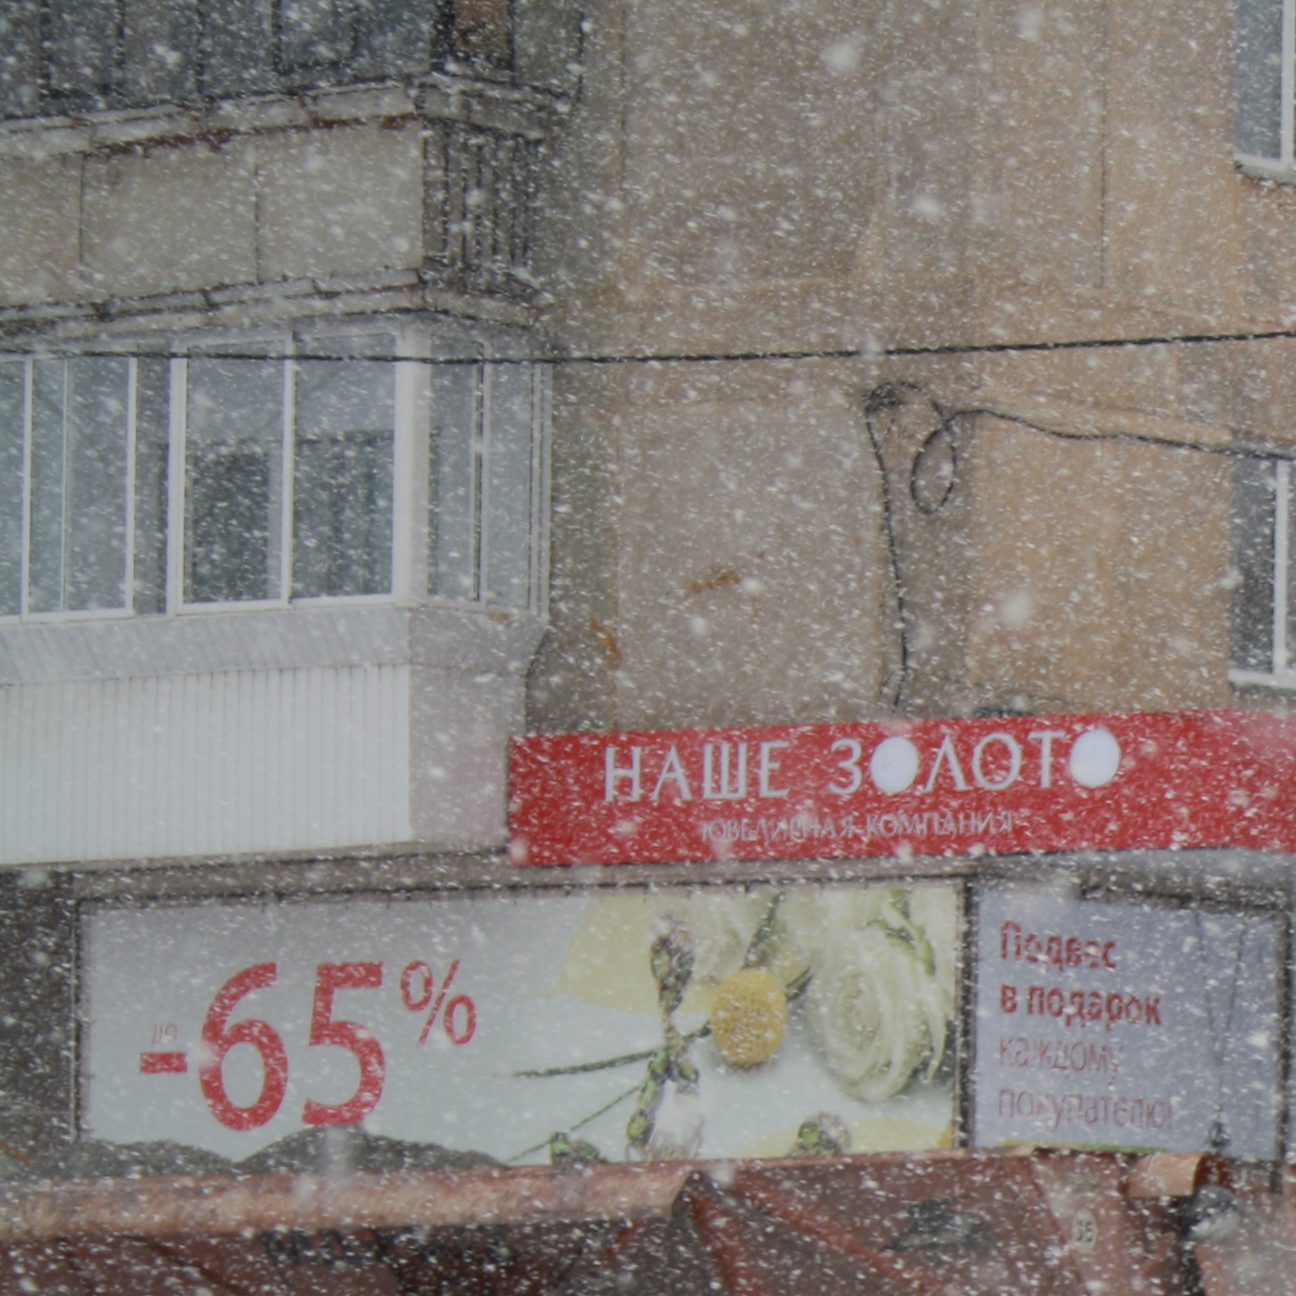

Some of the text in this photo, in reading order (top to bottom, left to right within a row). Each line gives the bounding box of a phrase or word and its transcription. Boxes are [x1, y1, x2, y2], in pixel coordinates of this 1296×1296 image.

[604, 728, 1121, 802] НАШЕ ЗОЛОТО
[701, 810, 1015, 843] ЮВЕЛИРНАЯ КОМПАНИЯ
[1001, 921, 1117, 973] Подвес
[1001, 985, 1162, 1032] в подарок
[139, 959, 477, 1131] -65%
